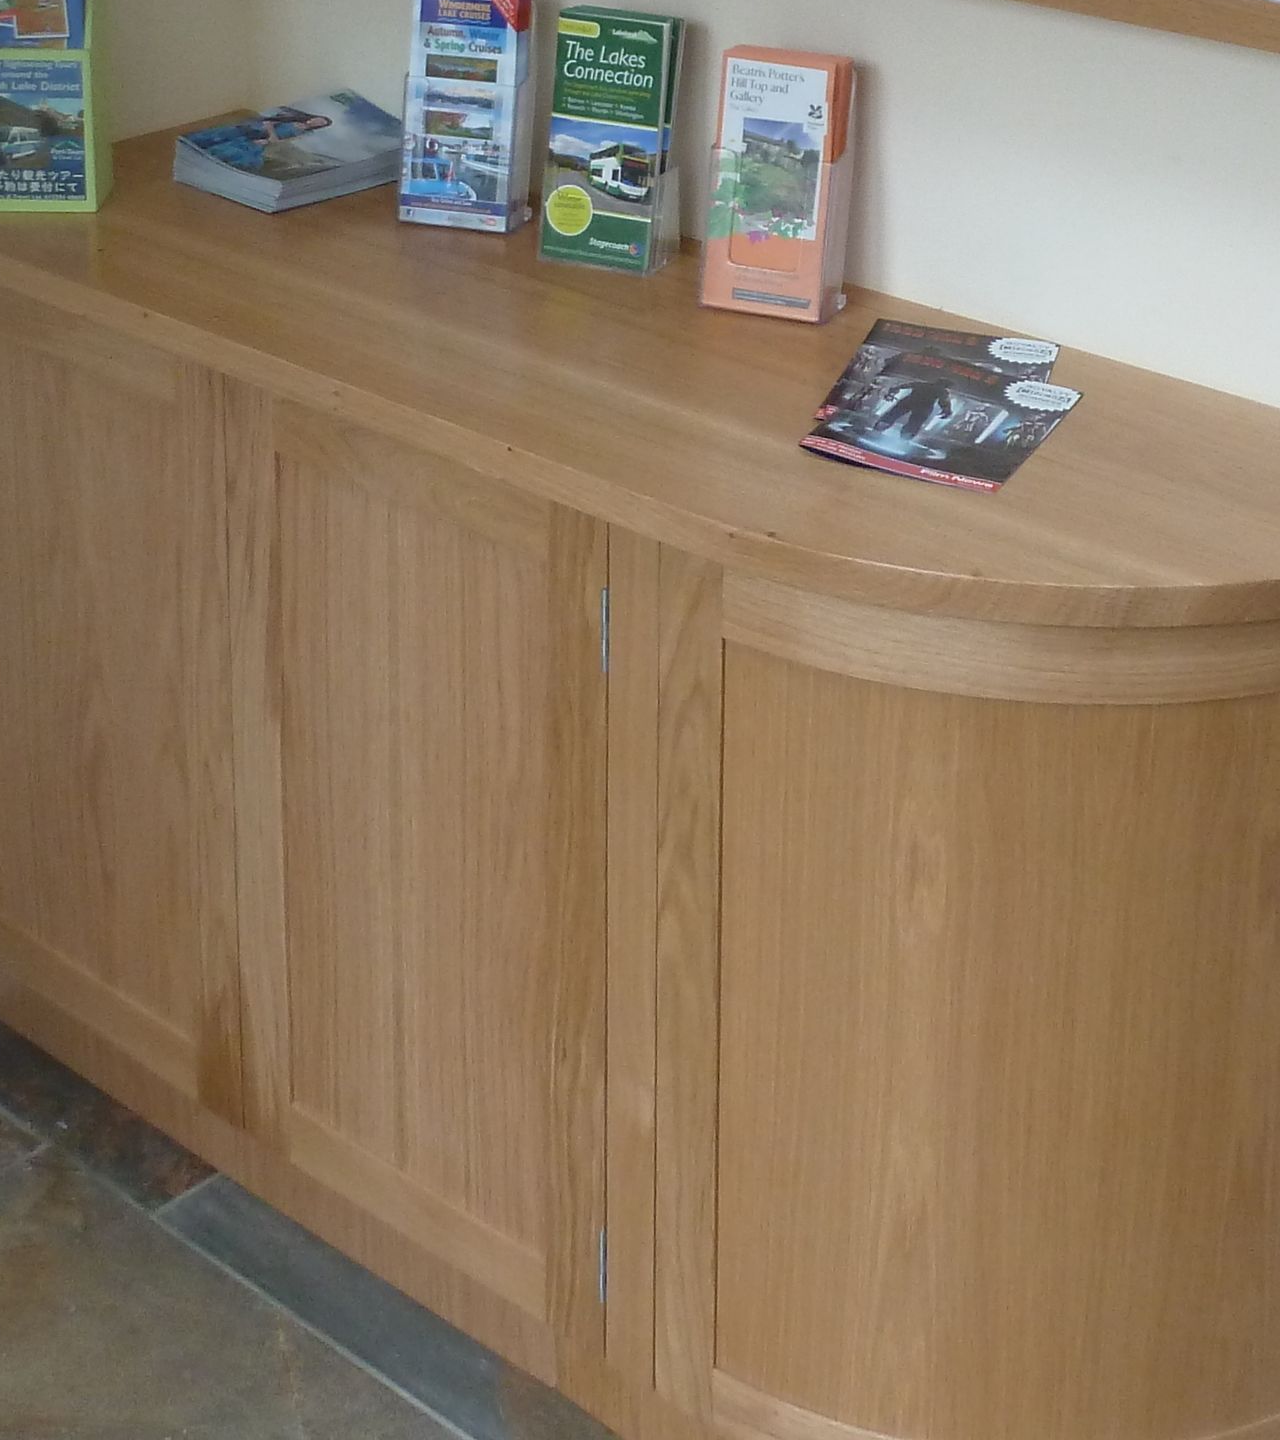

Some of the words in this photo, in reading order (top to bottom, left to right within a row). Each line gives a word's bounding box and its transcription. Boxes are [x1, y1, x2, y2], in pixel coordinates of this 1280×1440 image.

[438, 9, 458, 17] LAKE
[459, 10, 491, 20] CRUISES
[427, 25, 465, 38] Autumn,
[469, 28, 500, 40] Winter
[423, 38, 431, 48] &
[434, 39, 466, 53] Spring
[469, 42, 502, 54] Cruises
[565, 40, 595, 62] The
[599, 45, 646, 69] Lakes
[564, 60, 654, 88] Connection
[732, 63, 766, 78] Beatrix
[768, 68, 806, 82] Potter's
[11, 80, 38, 92] Lake
[40, 81, 81, 91] District
[731, 77, 747, 89] Hill
[749, 79, 768, 93] Top
[769, 84, 789, 94] and
[730, 90, 764, 104] Gallery
[588, 236, 630, 250] Stagecoach
